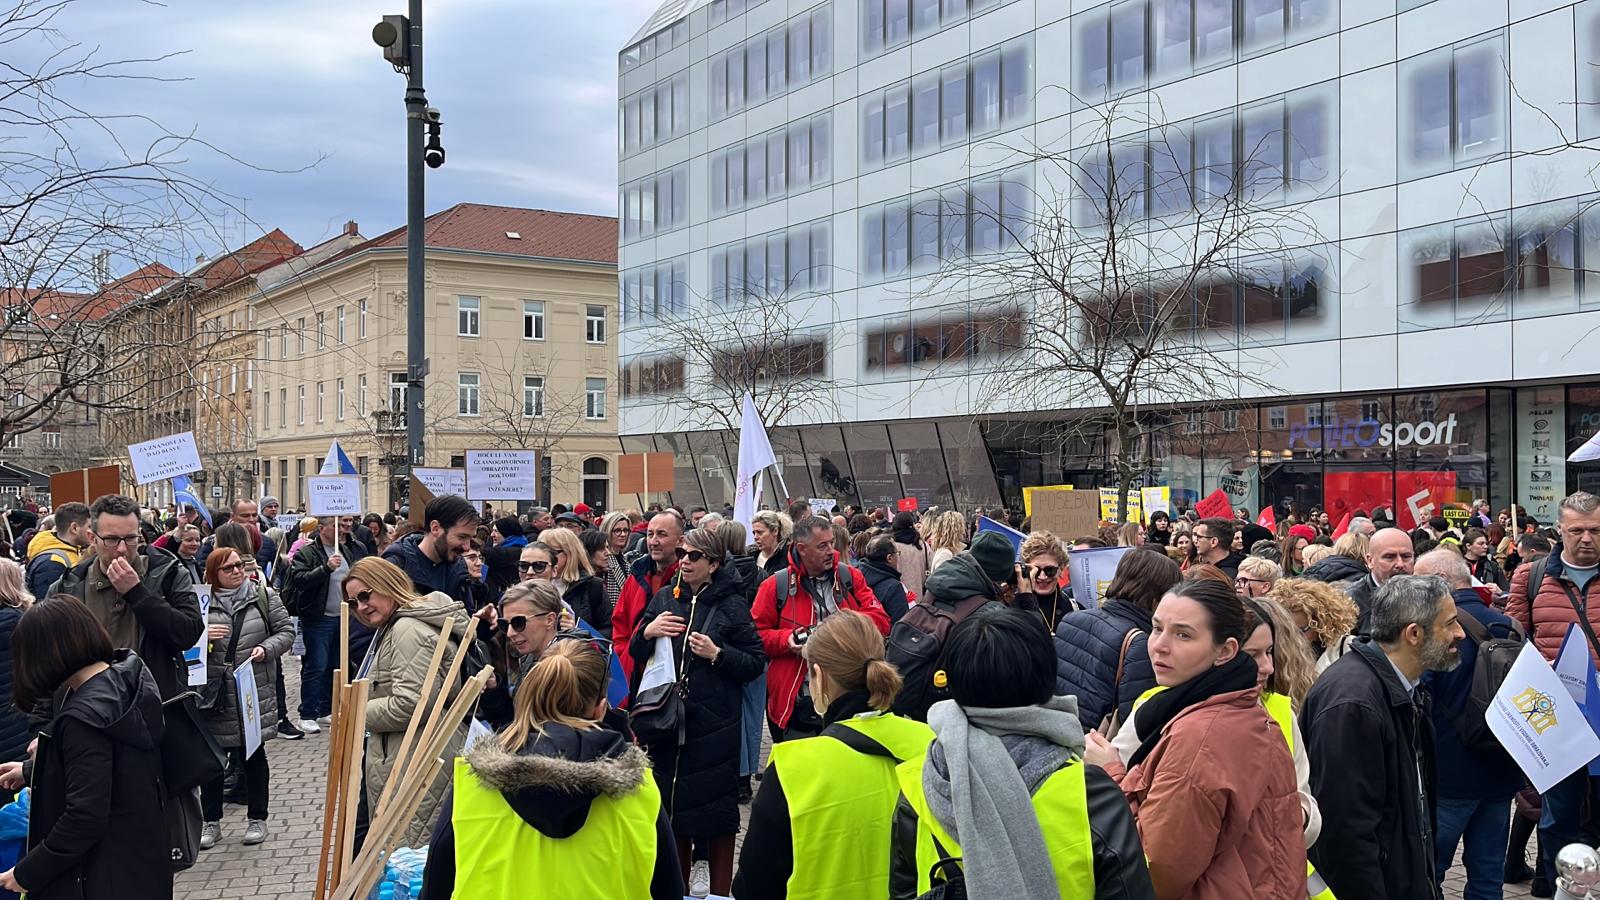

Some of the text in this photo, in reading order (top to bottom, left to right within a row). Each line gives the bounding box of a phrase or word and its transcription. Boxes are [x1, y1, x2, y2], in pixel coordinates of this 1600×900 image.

[158, 460, 177, 468] SAMO
[1222, 484, 1245, 496] KING
[1444, 510, 1457, 518] LAST
